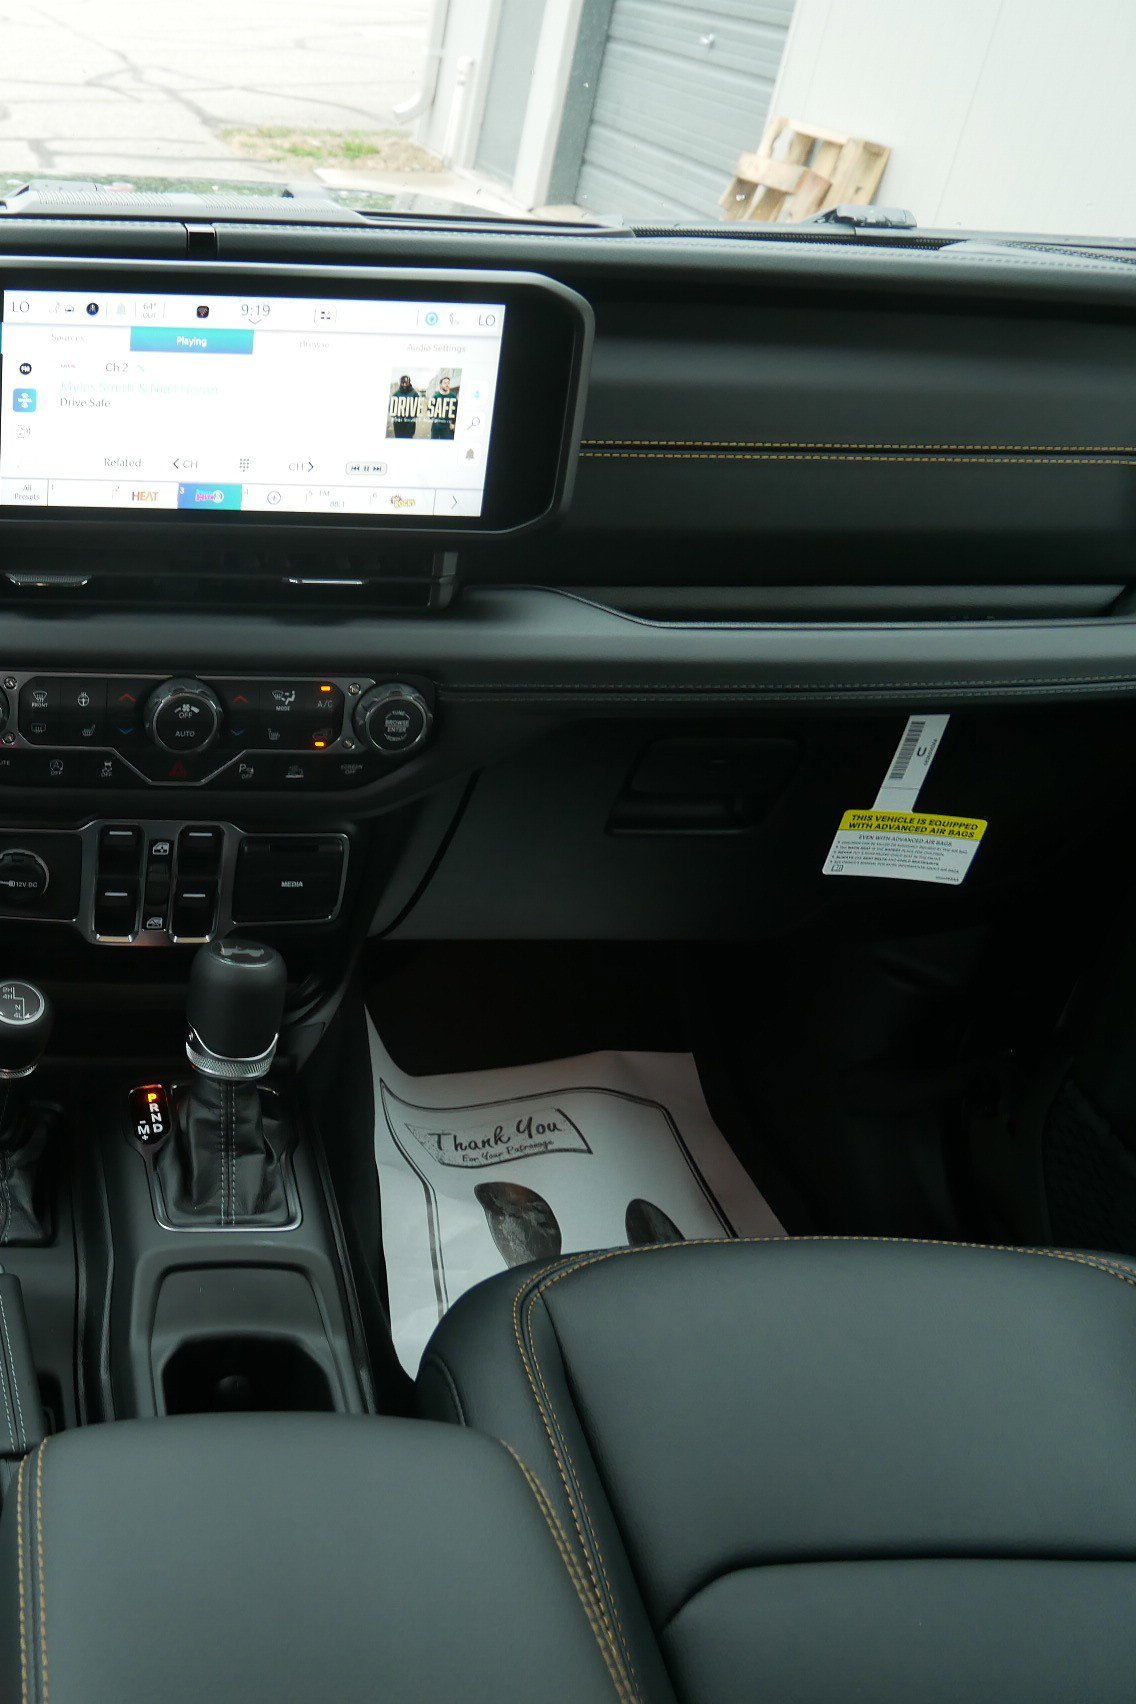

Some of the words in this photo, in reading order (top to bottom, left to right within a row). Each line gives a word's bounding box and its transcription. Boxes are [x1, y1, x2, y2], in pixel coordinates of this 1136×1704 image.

[12, 300, 30, 313] LO
[241, 304, 271, 317] 9:19
[478, 314, 496, 327] LO
[176, 336, 207, 348] Playing
[407, 343, 431, 352] Audio
[432, 344, 466, 354] Settings
[60, 398, 86, 407] Drive
[87, 399, 111, 409] Safe
[389, 396, 424, 417] DRIVE
[427, 397, 457, 419] SAFE
[104, 457, 142, 467] Related
[182, 459, 199, 469] CH
[288, 462, 304, 472] CH
[131, 490, 159, 502] HEAT
[317, 700, 333, 708] A/C
[178, 711, 193, 719] OFF
[852, 814, 873, 822] THIS
[875, 815, 915, 824] VEHICLE
[929, 819, 979, 830] EQUIPPED
[875, 823, 928, 833] ADVANCED
[948, 829, 975, 838] BAGS
[281, 880, 304, 888] MEDIA
[147, 1093, 157, 1103] P
[149, 1103, 160, 1112] R
[150, 1112, 162, 1123] N
[137, 1124, 150, 1135] M
[152, 1123, 164, 1133] D
[428, 1125, 511, 1152] Thank
[515, 1116, 562, 1139] You
[462, 1154, 479, 1162] For
[481, 1151, 503, 1161] Your
[506, 1140, 554, 1154] Patronage
